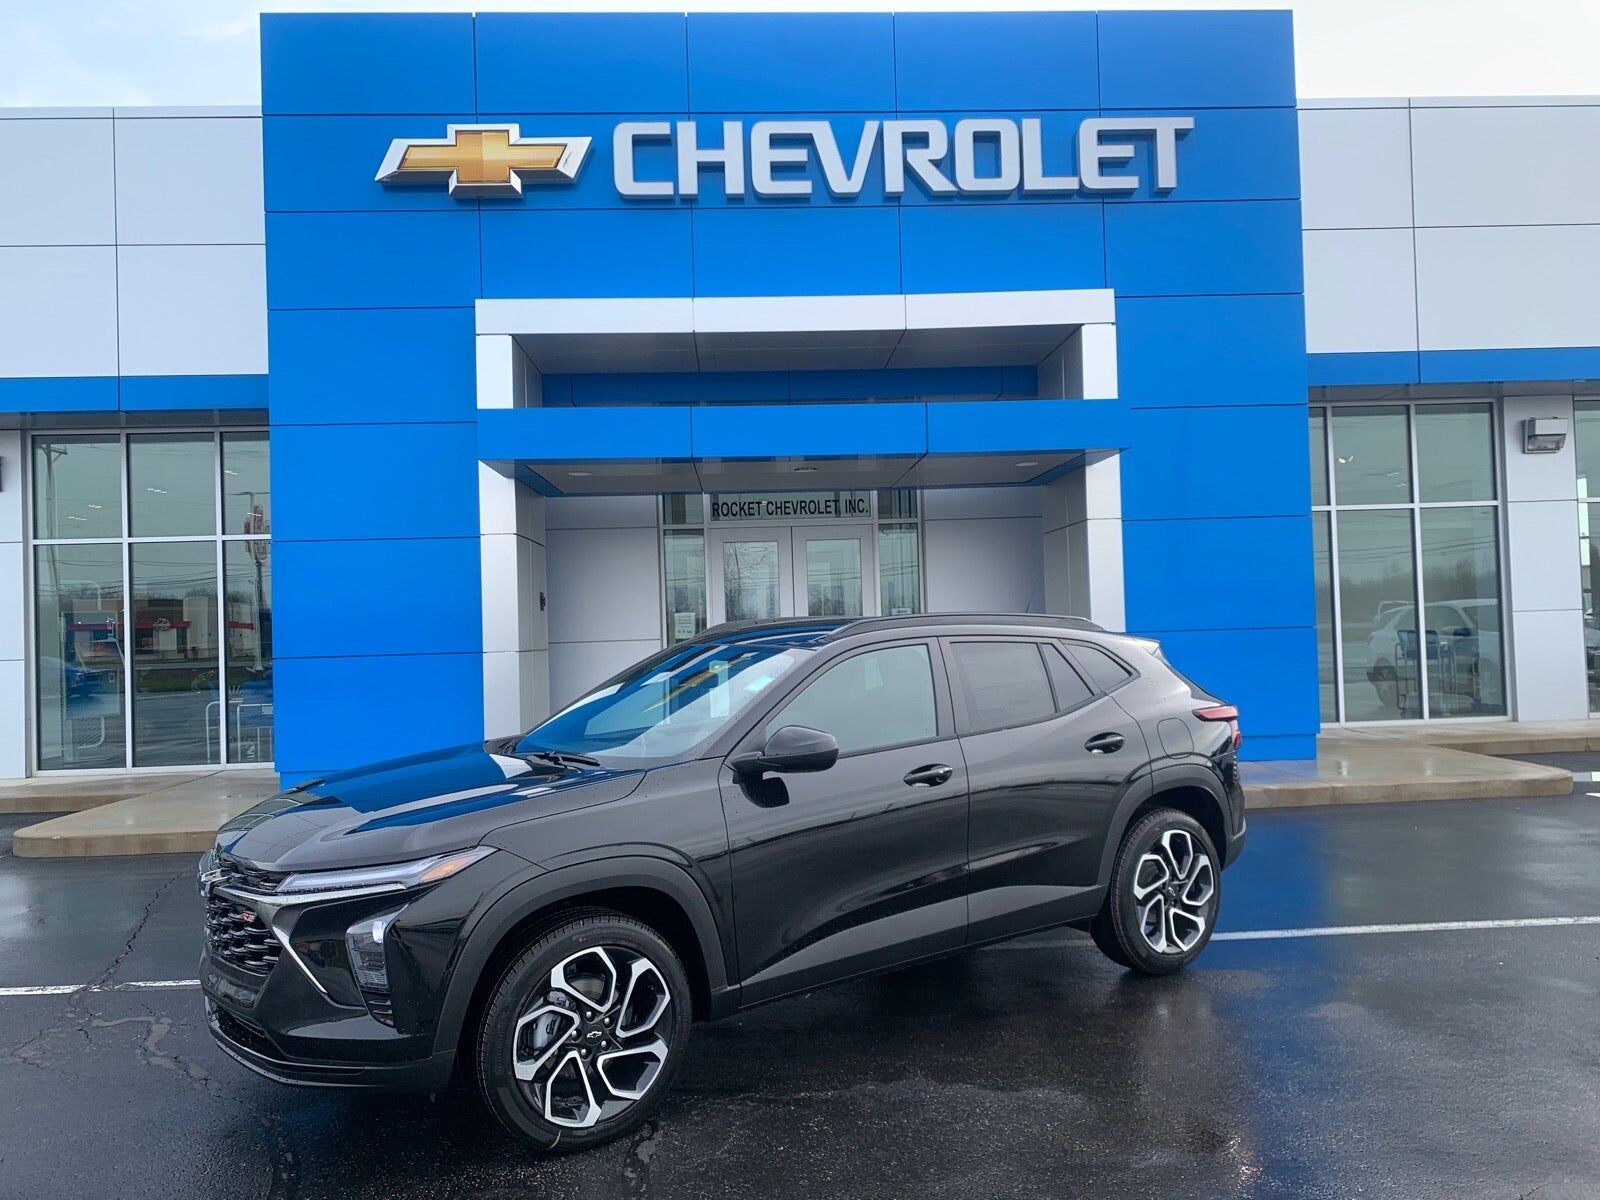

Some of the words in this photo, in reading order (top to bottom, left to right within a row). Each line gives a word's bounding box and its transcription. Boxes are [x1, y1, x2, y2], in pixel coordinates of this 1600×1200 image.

[613, 116, 1196, 198] CHEVROLET
[712, 501, 762, 517] ROCKET
[845, 498, 869, 513] INC.
